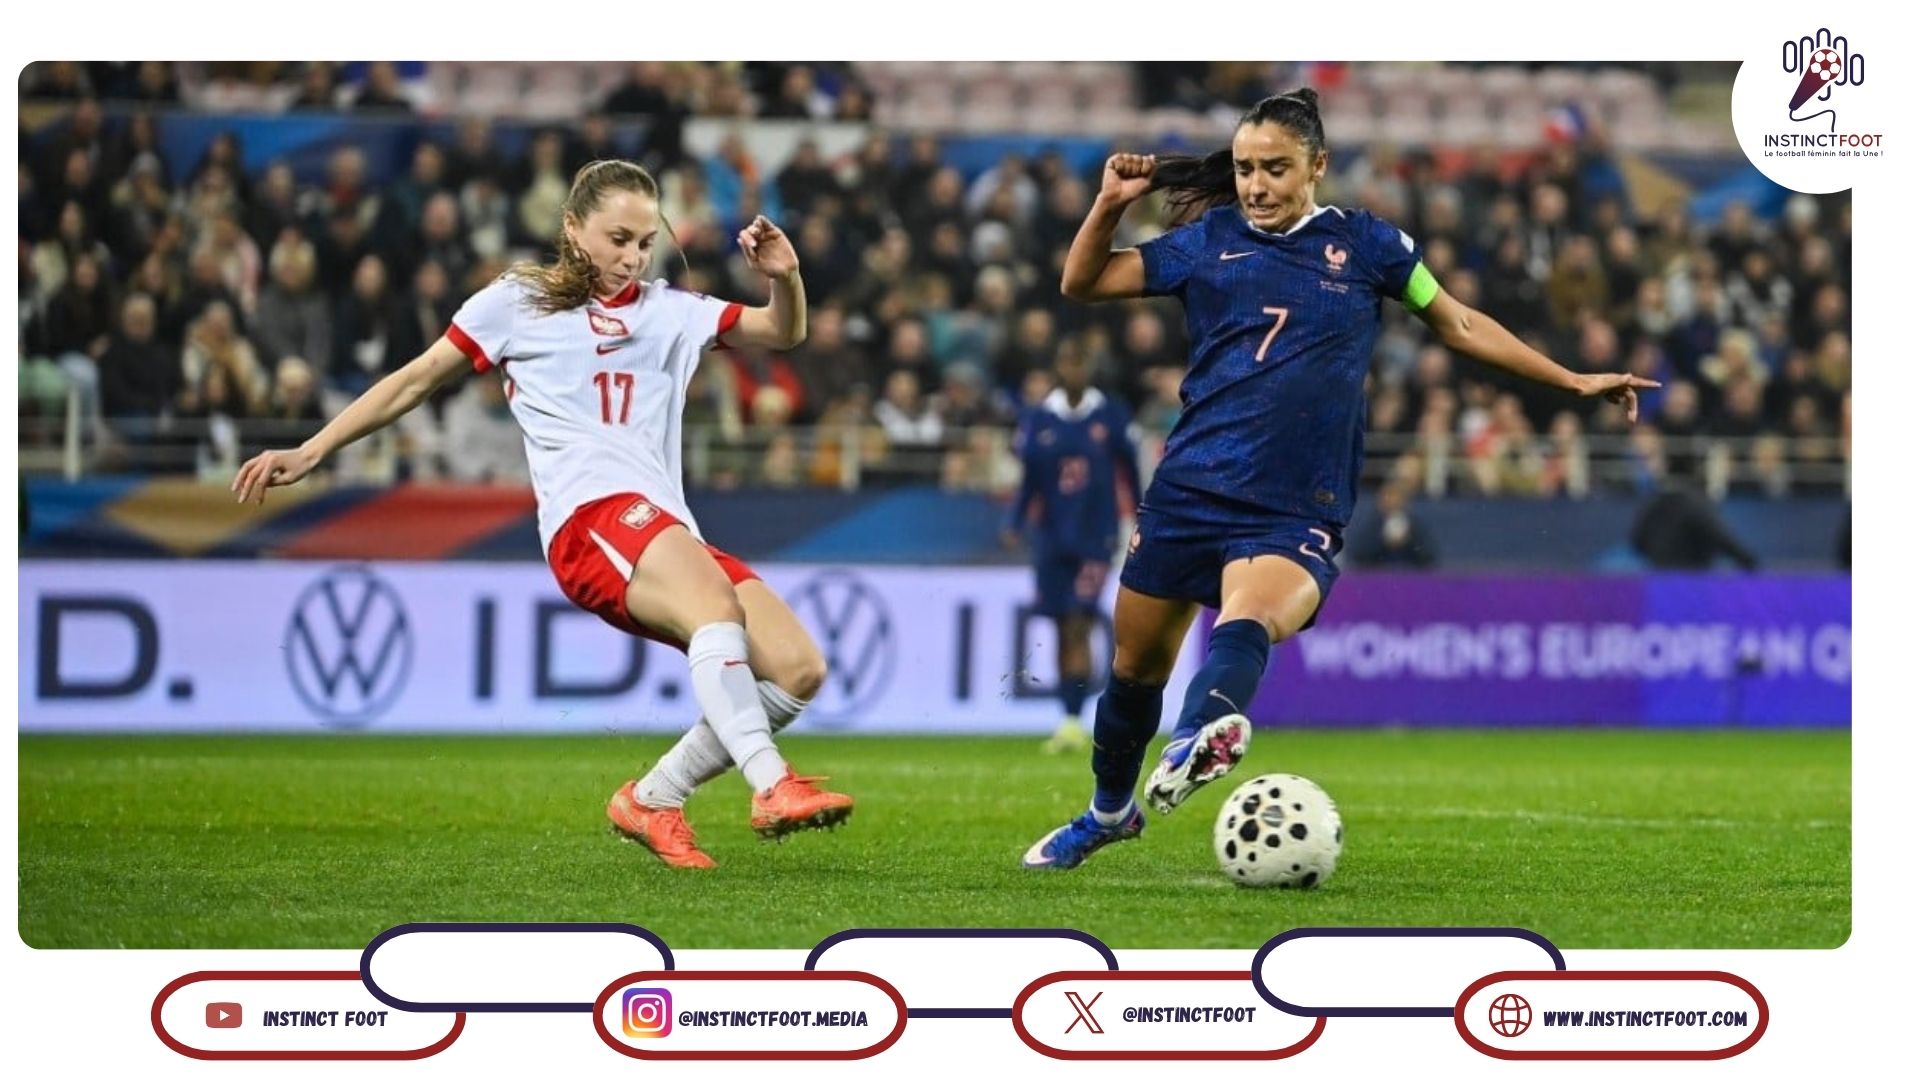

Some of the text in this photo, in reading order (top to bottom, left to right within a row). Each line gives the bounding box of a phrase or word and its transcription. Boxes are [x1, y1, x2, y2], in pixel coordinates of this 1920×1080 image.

[1255, 307, 1289, 362] 7
[593, 372, 635, 426] 17
[1299, 621, 1533, 680] WOMEN'S
